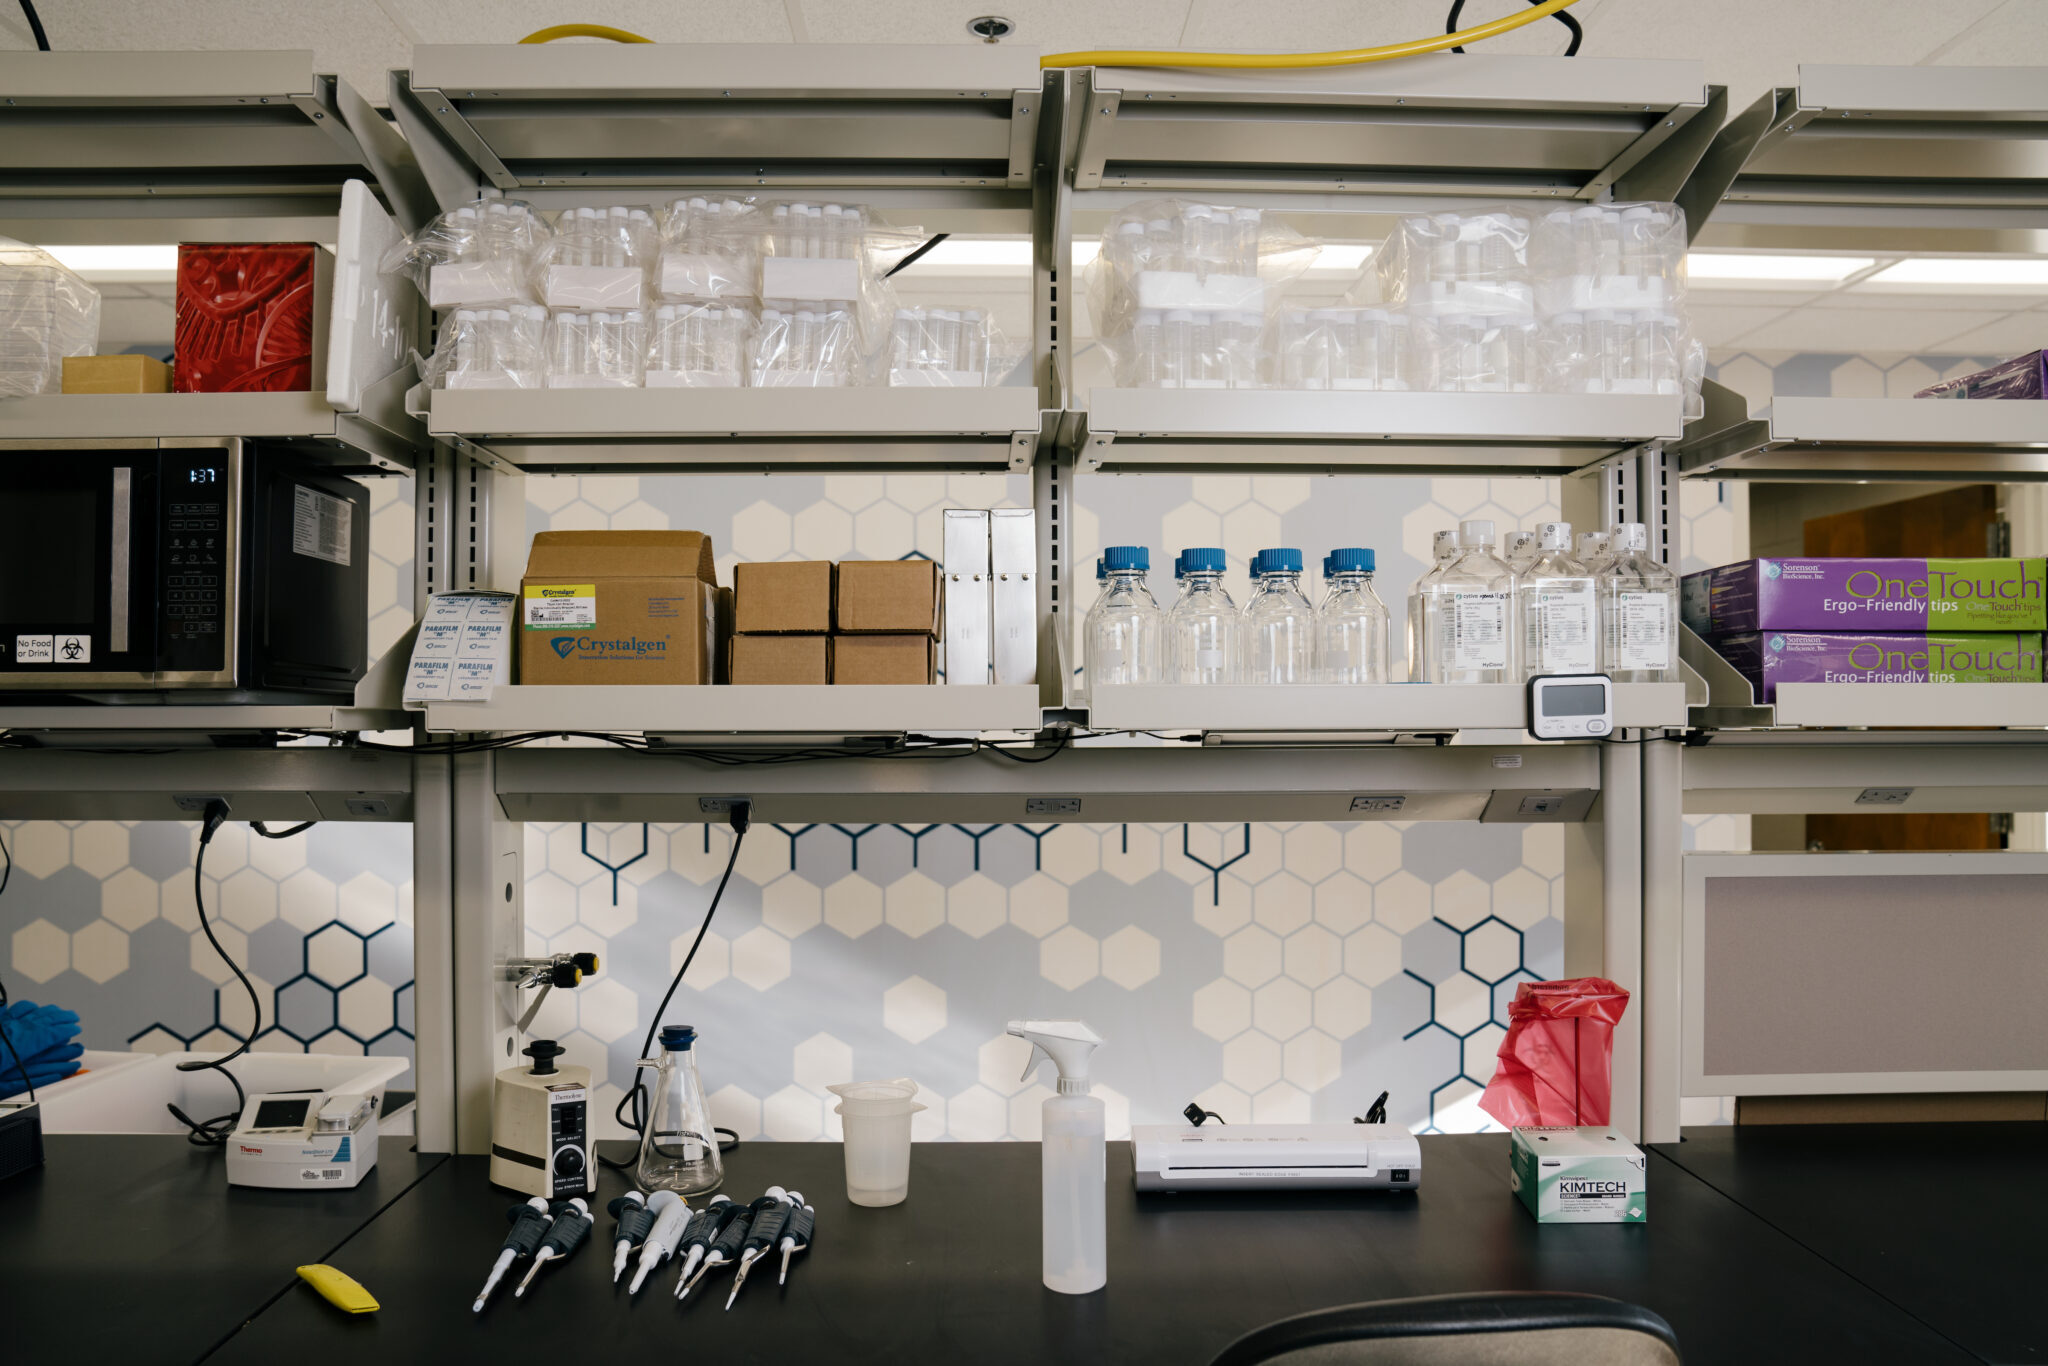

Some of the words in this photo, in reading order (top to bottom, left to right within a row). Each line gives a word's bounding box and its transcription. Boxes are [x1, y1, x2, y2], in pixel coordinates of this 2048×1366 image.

[190, 468, 215, 483] 1:37
[1783, 563, 1819, 571] Sorenson
[1823, 599, 1926, 614] Ergo-Friendly
[1931, 600, 1959, 614] tips
[577, 636, 666, 655] Crystalgen
[1929, 671, 1956, 683] tips
[240, 1145, 263, 1154] Thermo
[1560, 1181, 1626, 1193] KIMTECH
